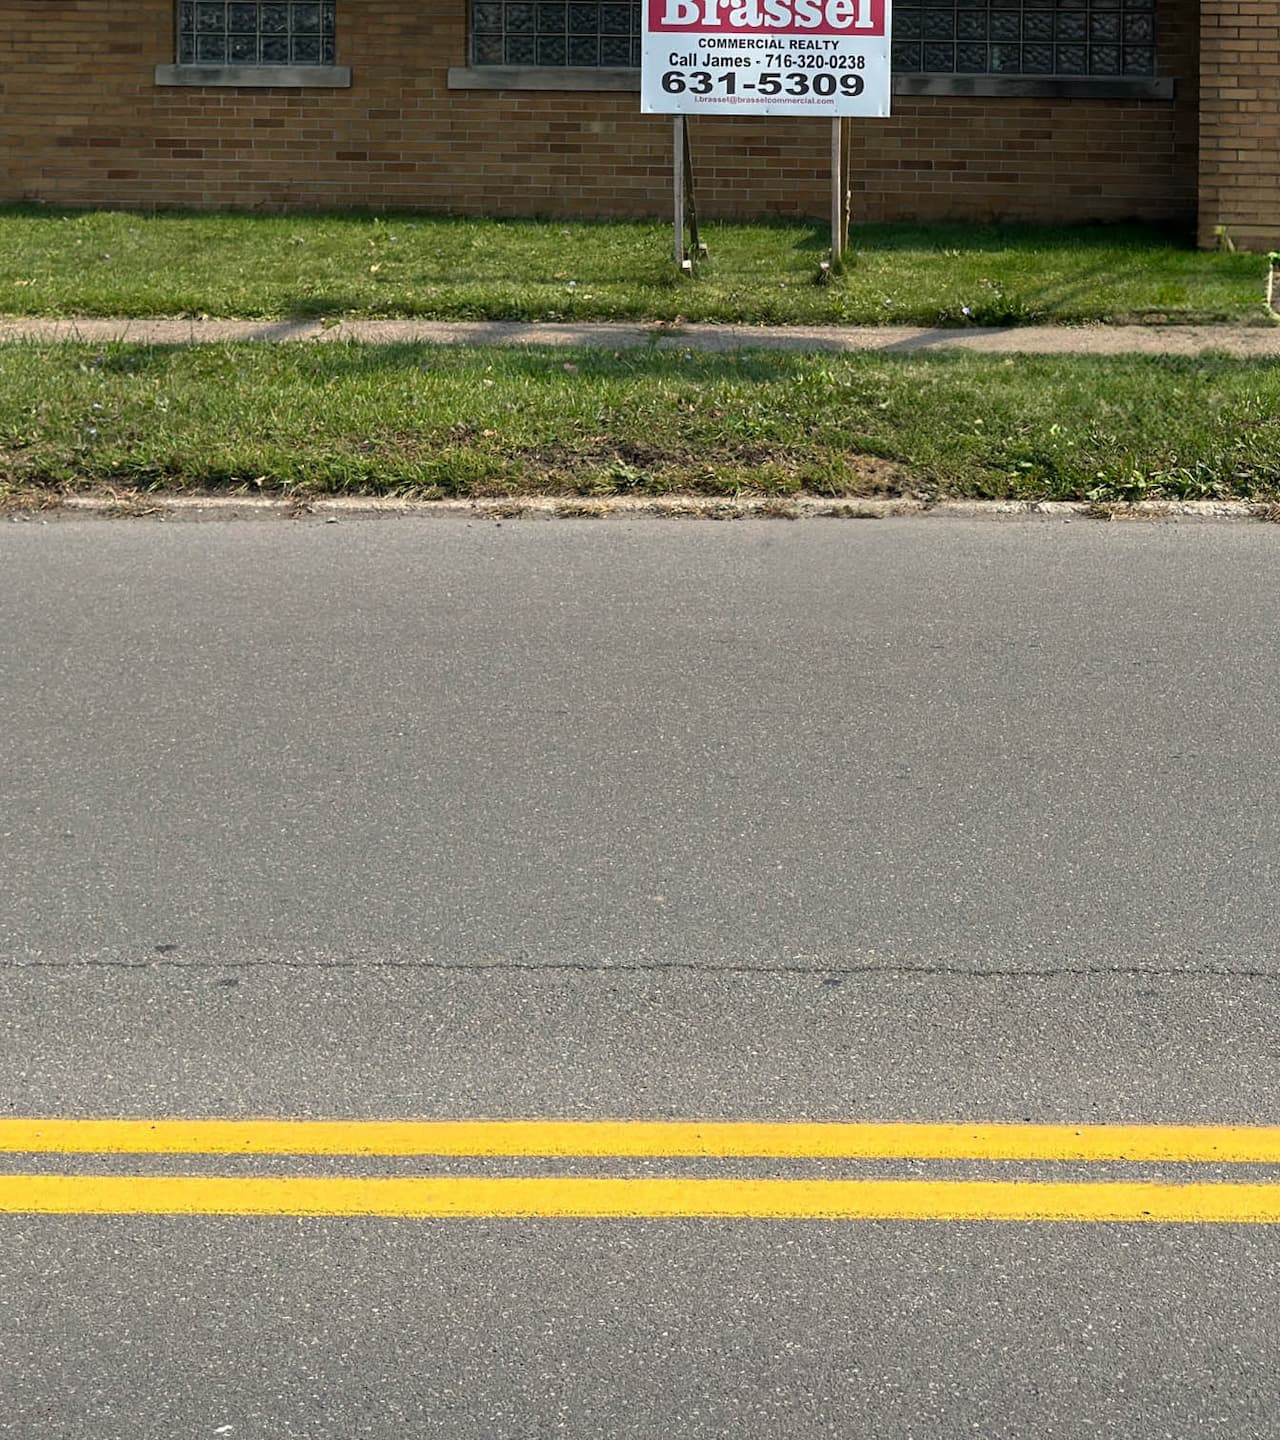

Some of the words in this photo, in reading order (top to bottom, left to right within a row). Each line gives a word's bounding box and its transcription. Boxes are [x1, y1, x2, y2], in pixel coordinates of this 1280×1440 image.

[698, 38, 785, 50] COMMERCIAL
[789, 40, 840, 51] REALTY
[669, 52, 697, 67] Call
[702, 53, 751, 68] James
[765, 54, 866, 69] 716-320-0238
[661, 71, 865, 97] 631-5309
